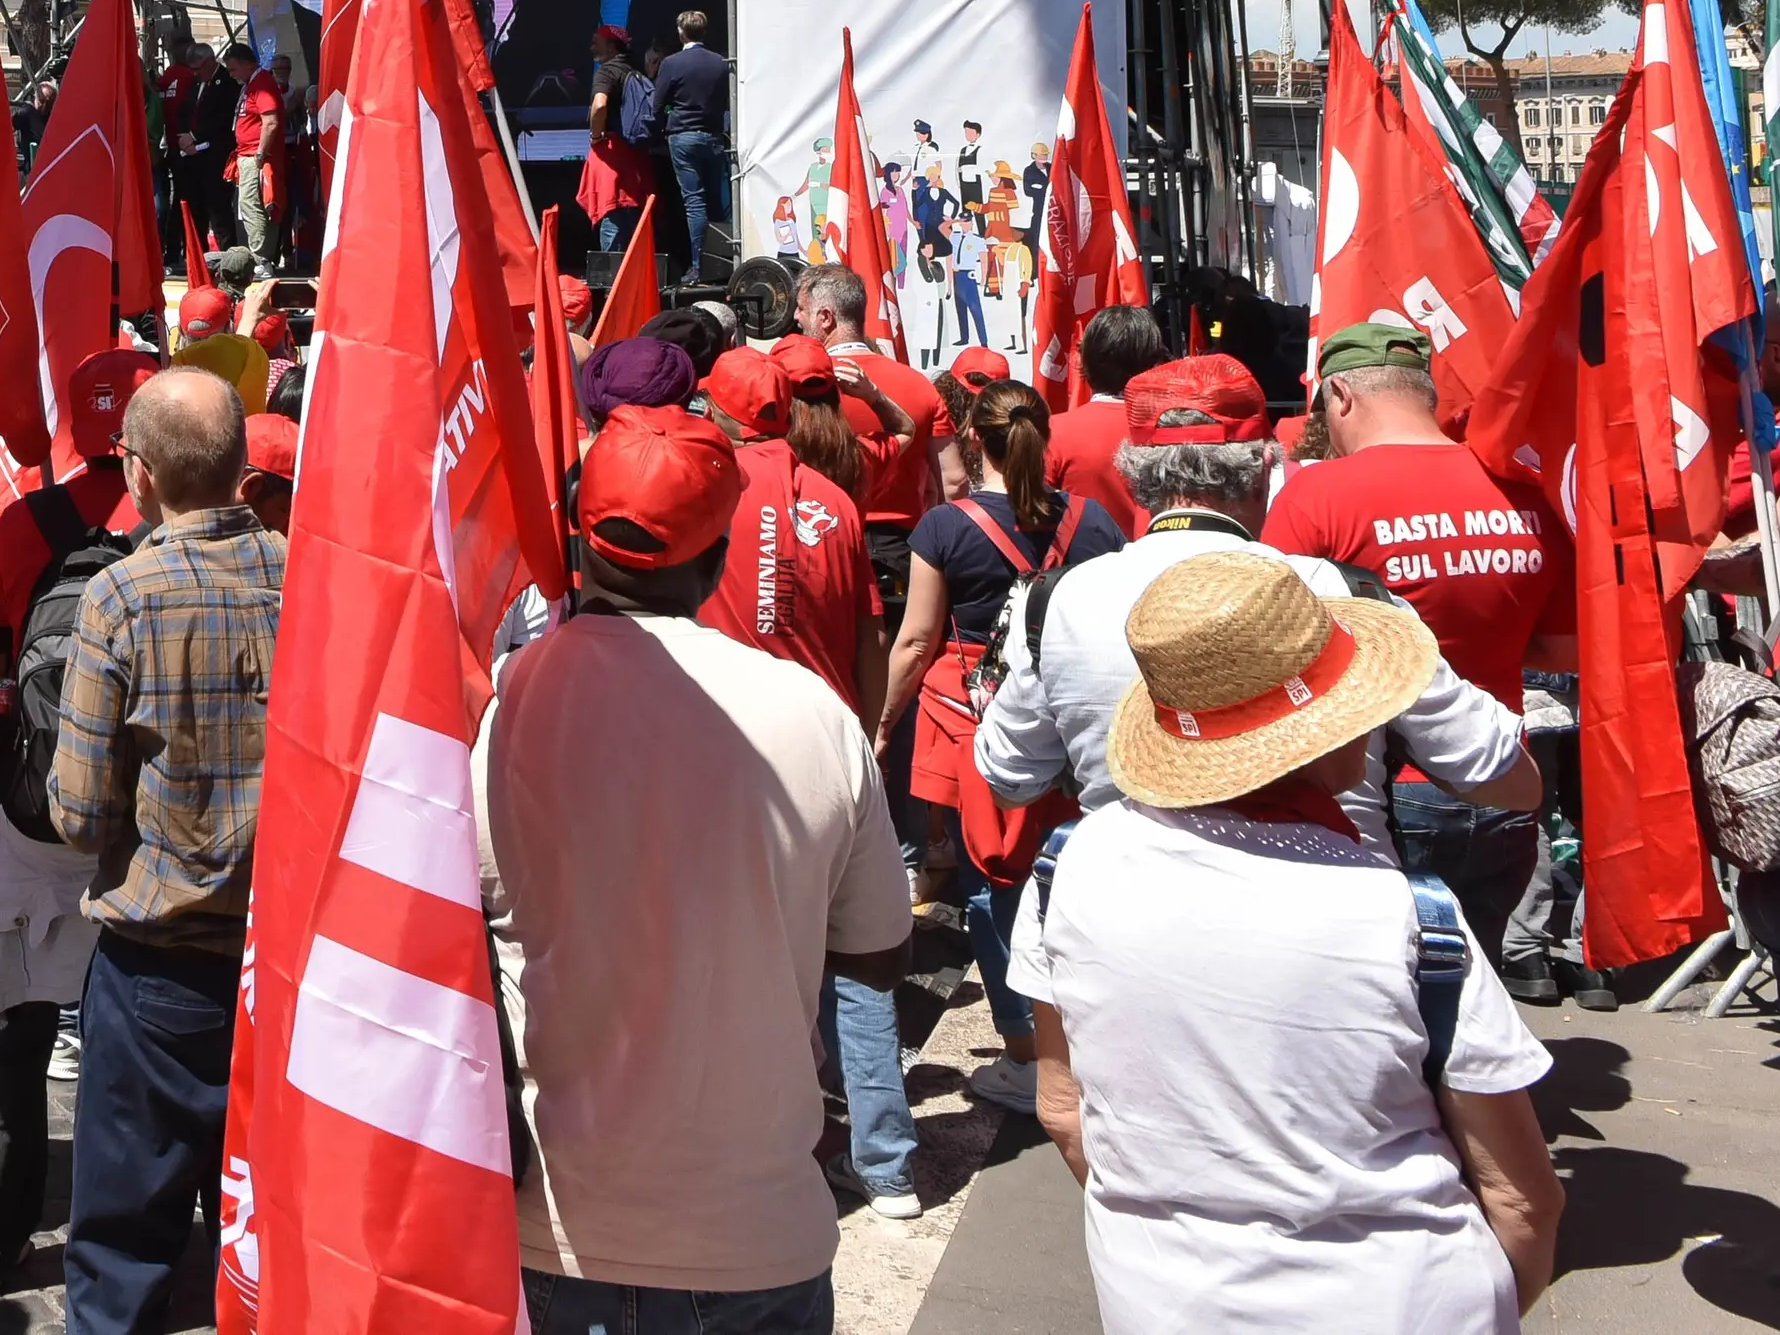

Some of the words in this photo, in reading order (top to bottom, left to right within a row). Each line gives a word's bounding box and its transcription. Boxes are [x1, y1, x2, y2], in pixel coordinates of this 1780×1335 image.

[1374, 512, 1459, 547] BASTA
[1464, 509, 1543, 537] MORTI
[757, 505, 778, 636] SEMINIAMO
[1386, 554, 1439, 582] SUL
[1446, 547, 1544, 576] LAVORO
[1292, 688, 1310, 703] SPI
